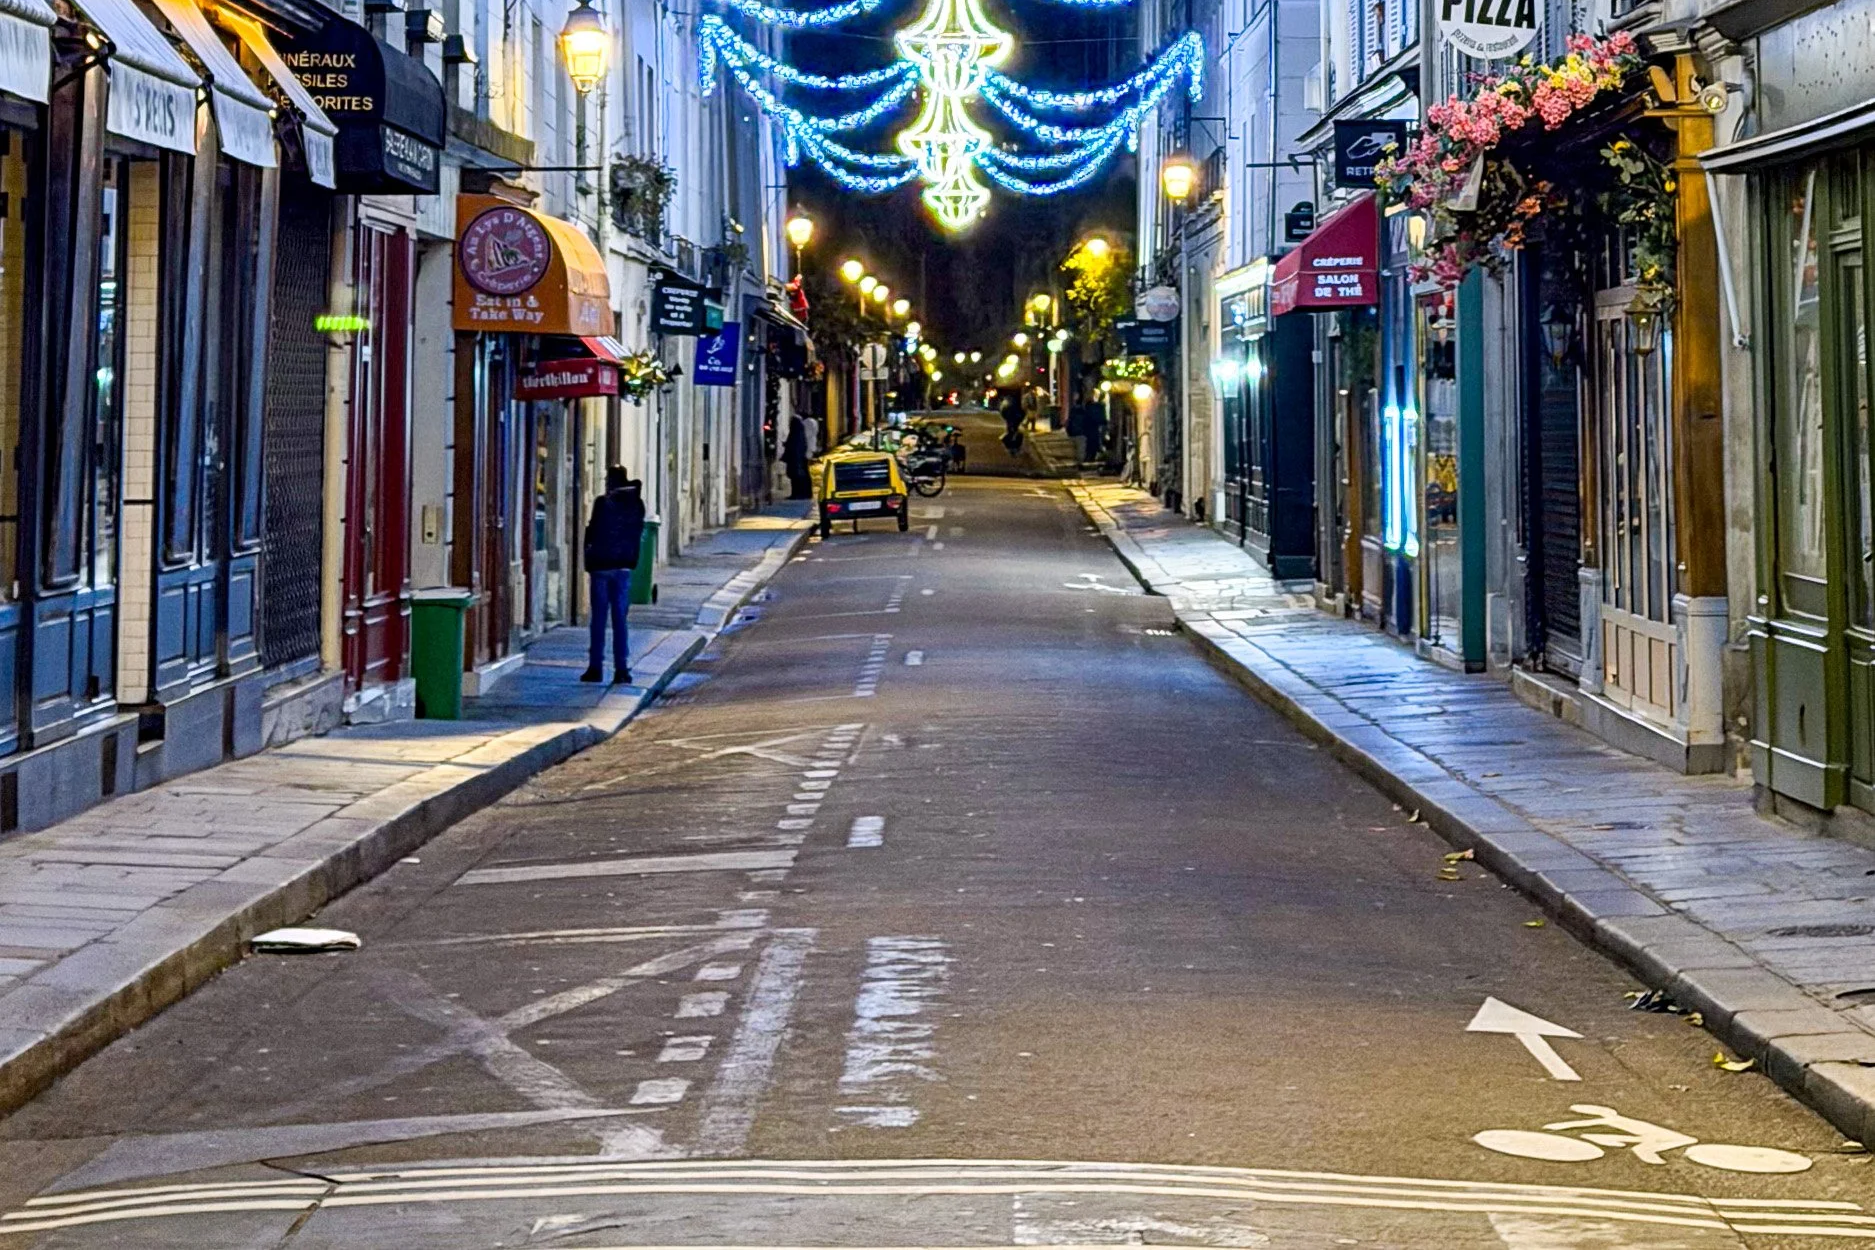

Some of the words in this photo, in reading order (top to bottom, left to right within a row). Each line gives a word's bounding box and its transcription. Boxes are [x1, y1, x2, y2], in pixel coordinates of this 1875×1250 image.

[278, 50, 356, 68] INÉRAUX
[1317, 274, 1359, 285] SALON
[1314, 287, 1332, 297] DE
[1337, 283, 1363, 297] THÉ
[476, 294, 501, 307] Eat
[526, 295, 540, 308] &
[469, 308, 508, 320] Take
[512, 308, 545, 324] Way
